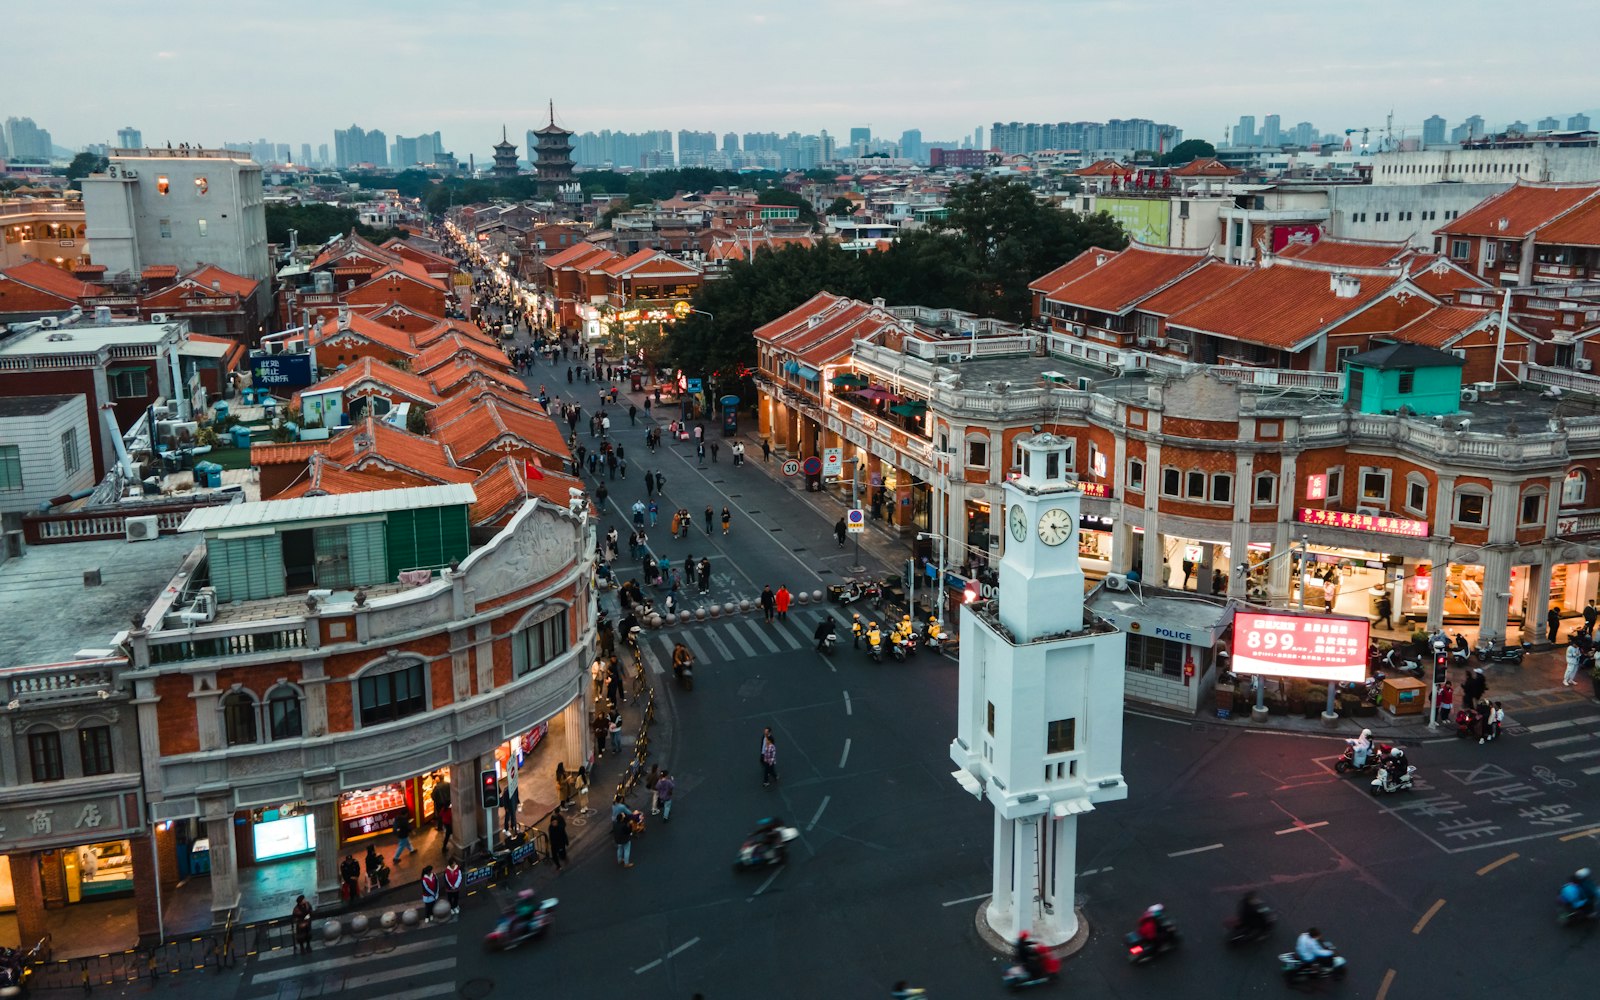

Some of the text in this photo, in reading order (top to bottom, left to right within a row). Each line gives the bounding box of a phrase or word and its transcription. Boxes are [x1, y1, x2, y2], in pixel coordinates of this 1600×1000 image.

[786, 464, 797, 473] 30
[1156, 627, 1192, 640] POLICE
[1247, 631, 1294, 651] 899
